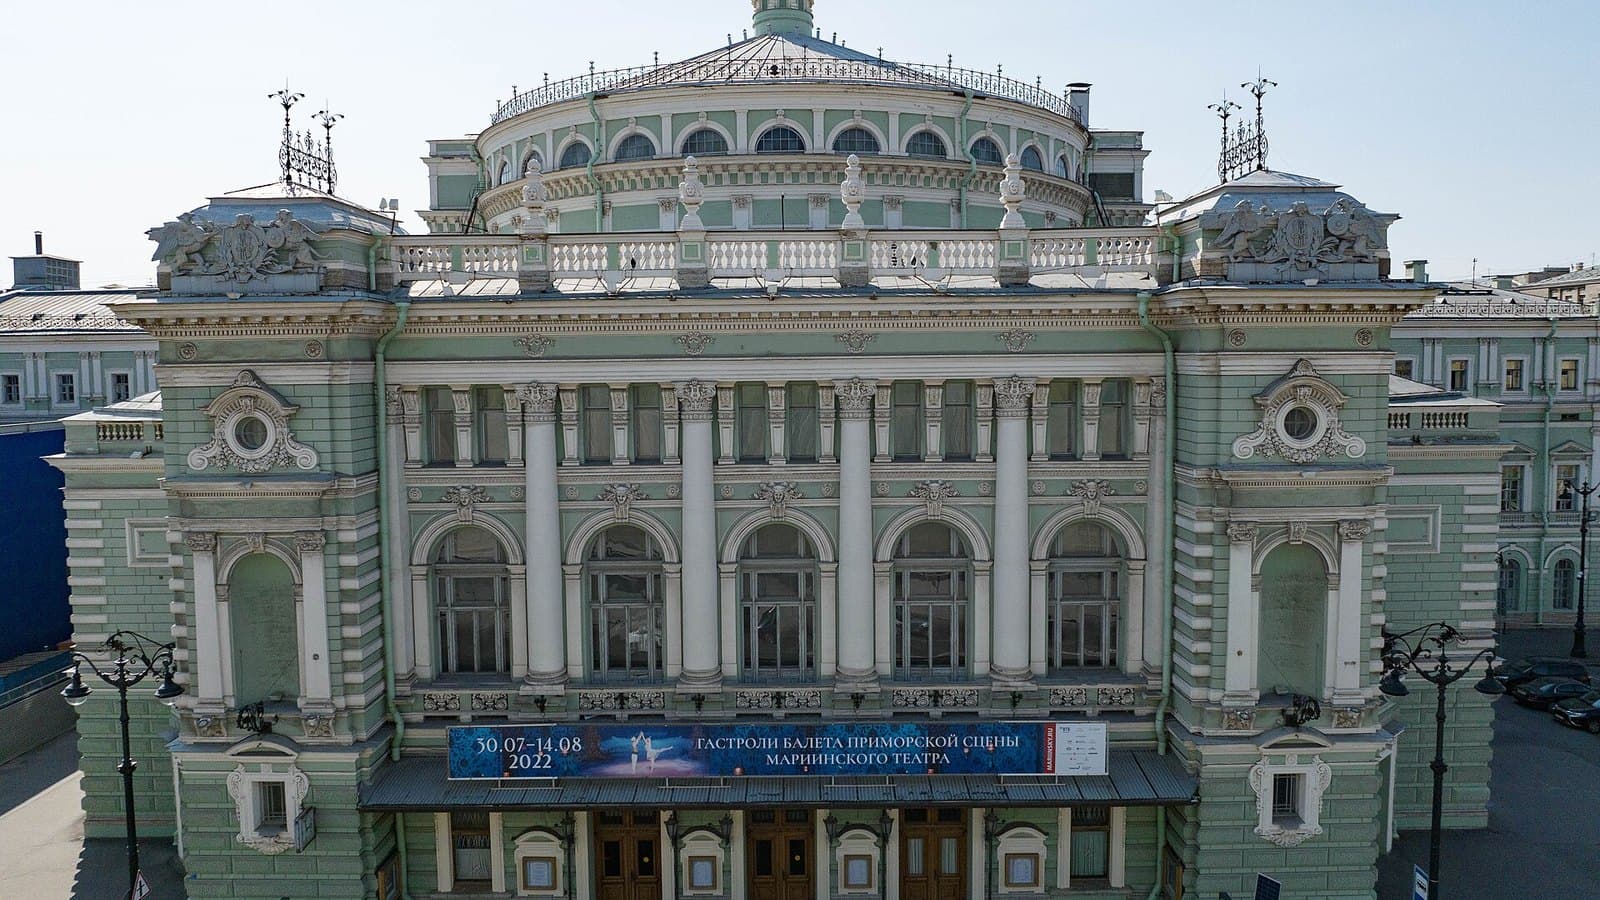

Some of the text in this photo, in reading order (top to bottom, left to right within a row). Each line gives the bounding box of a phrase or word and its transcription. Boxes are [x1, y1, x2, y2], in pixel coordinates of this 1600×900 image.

[697, 733, 1019, 749] ГАСТРОЛИ БАЛЕТА ПРИМОРСКОЙ СЦЕНЫ
[509, 754, 552, 769] 2022
[766, 752, 951, 766] МАРИИНСКОГО ТЕАТРА
